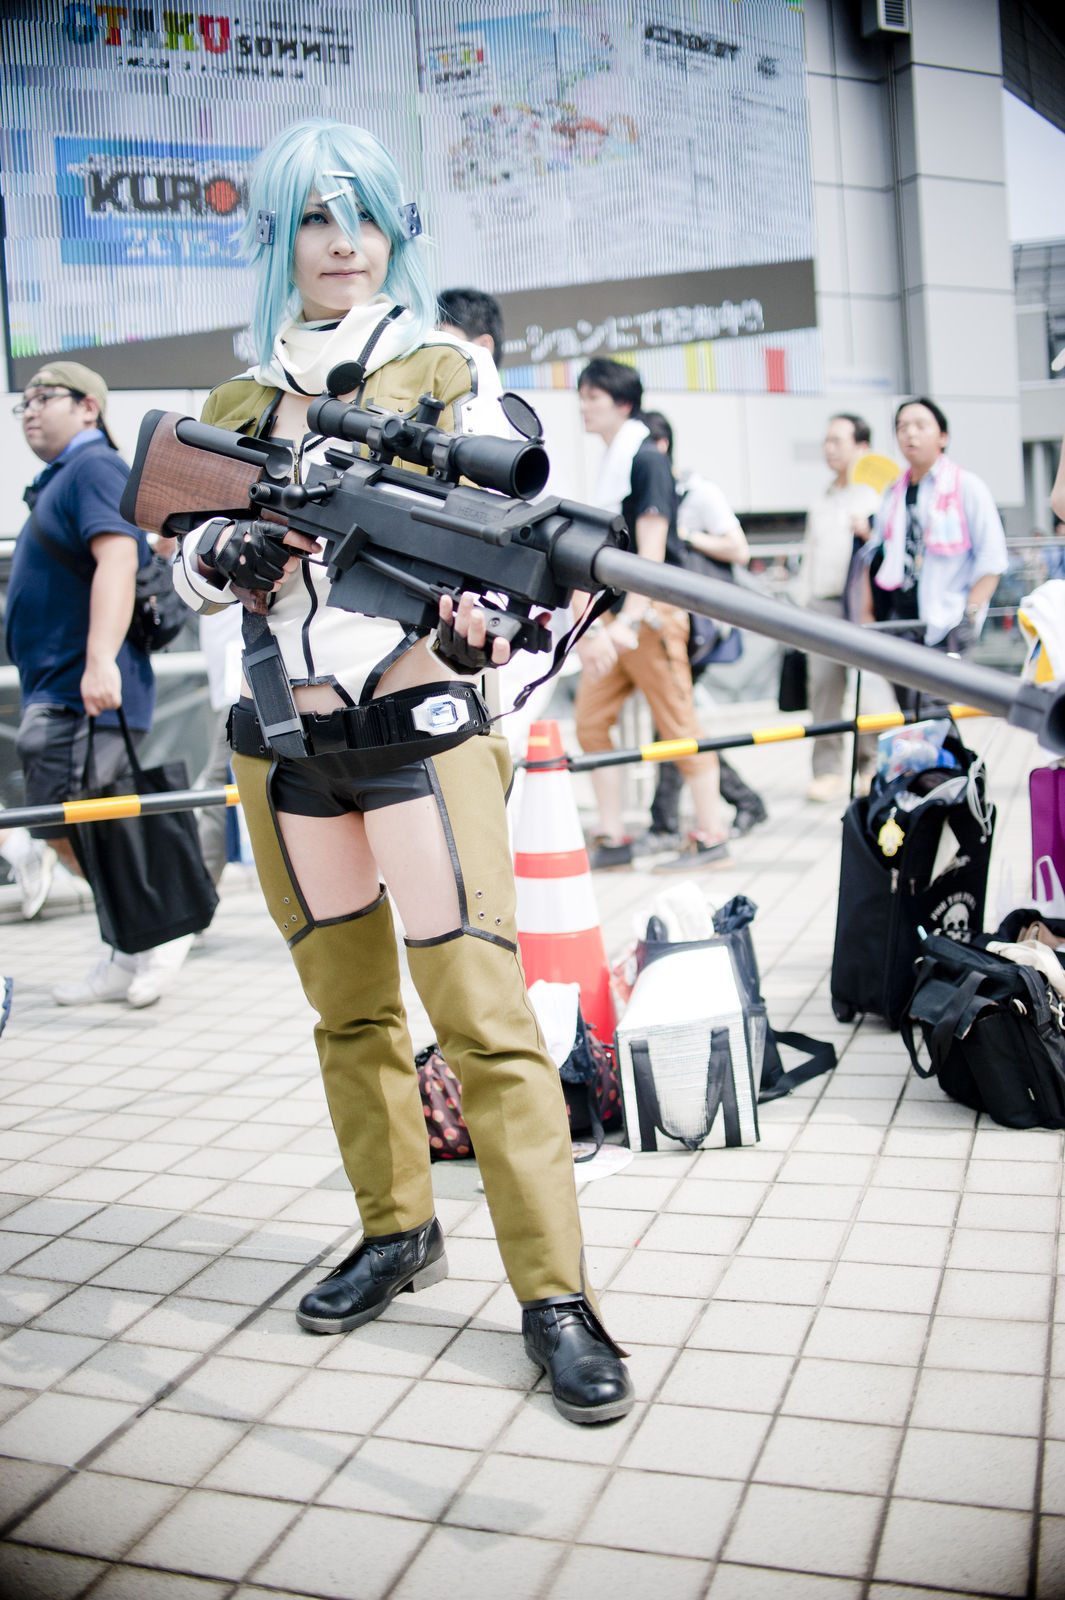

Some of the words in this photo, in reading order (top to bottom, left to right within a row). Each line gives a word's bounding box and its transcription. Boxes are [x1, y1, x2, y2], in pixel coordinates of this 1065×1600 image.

[63, 2, 231, 55] OTAKU
[238, 34, 354, 65] SUMMIT
[90, 170, 248, 217] KURO
